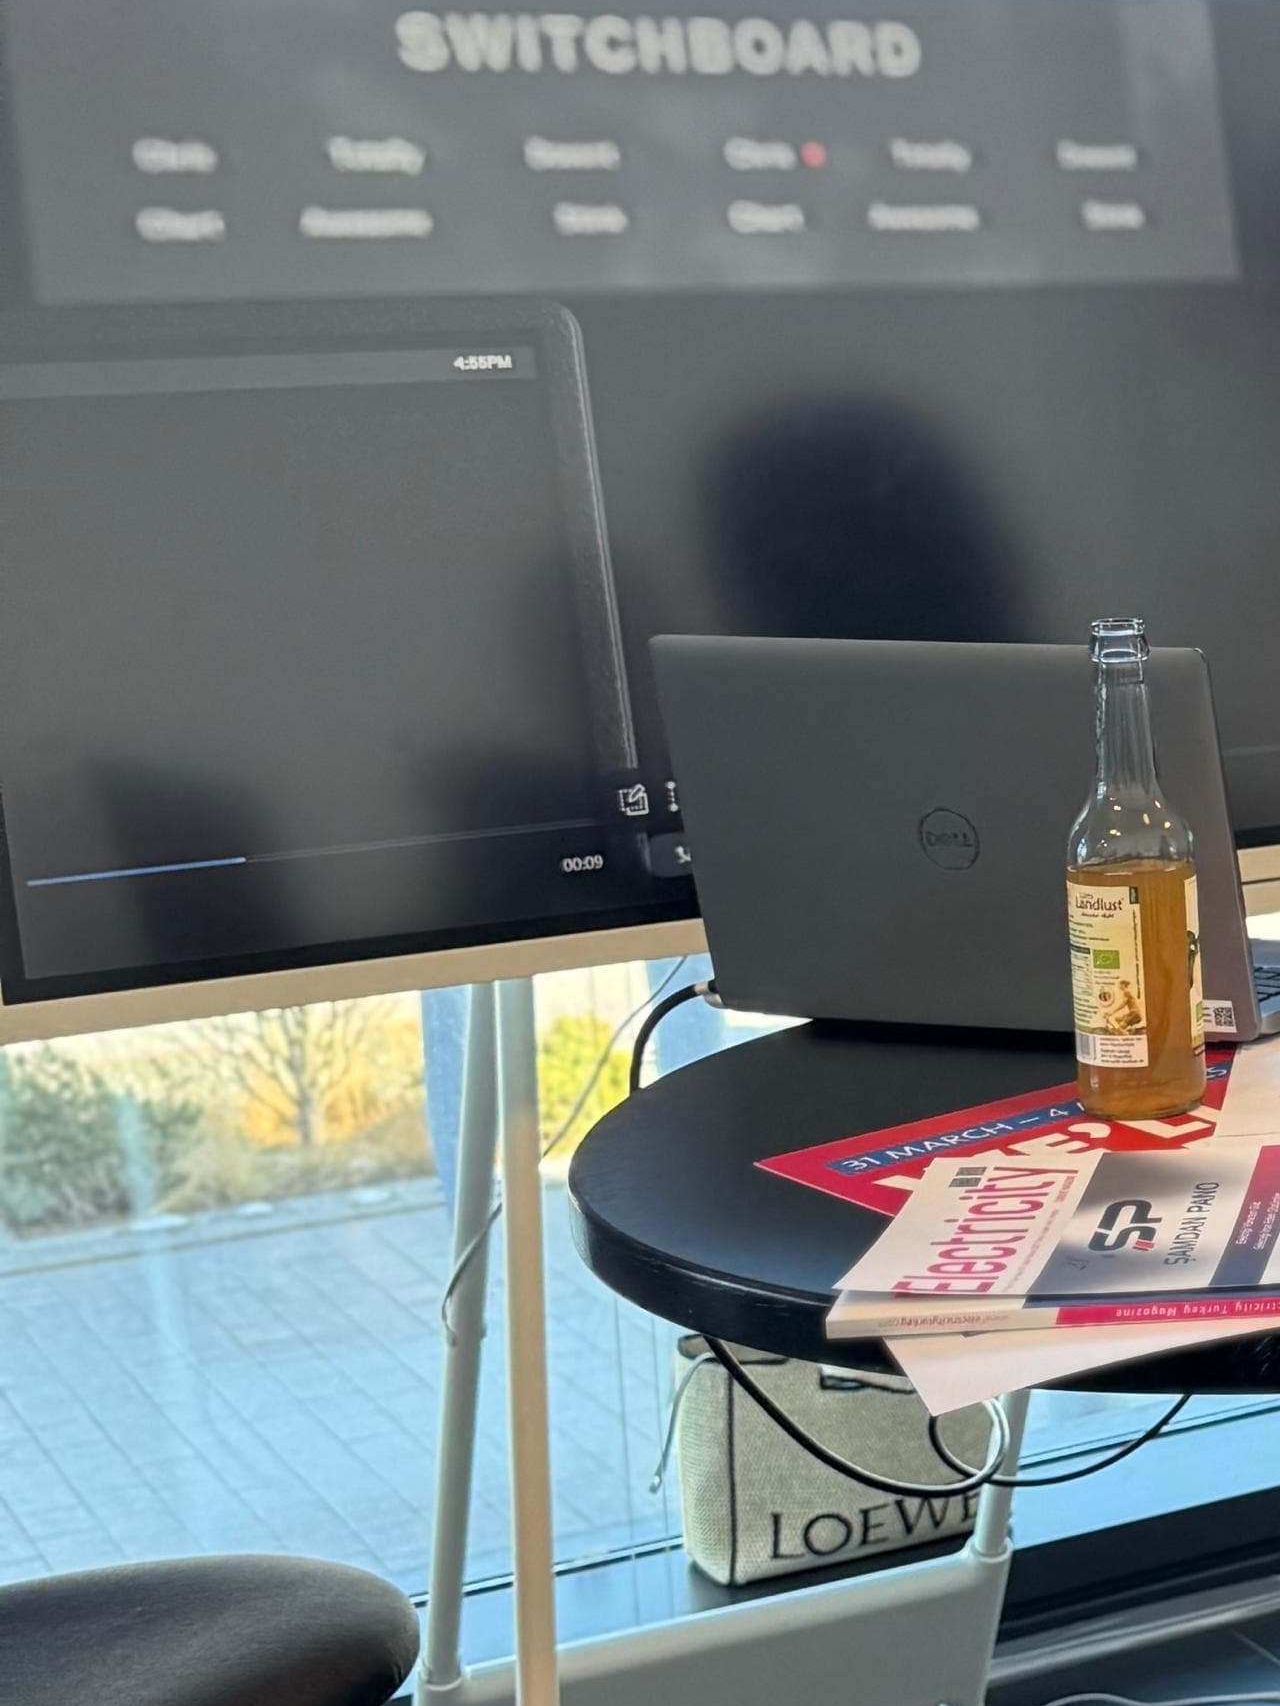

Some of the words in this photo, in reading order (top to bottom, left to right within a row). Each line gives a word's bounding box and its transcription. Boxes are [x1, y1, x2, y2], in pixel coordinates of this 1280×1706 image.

[395, 10, 923, 78] SWITCHBOARD
[562, 855, 604, 872] 00:09
[843, 1155, 881, 1173] 31
[886, 1122, 1010, 1161] MARCH
[890, 1165, 1079, 1297] Electricity
[1115, 1305, 1177, 1320] Magazine
[1184, 1302, 1227, 1318] Turkey
